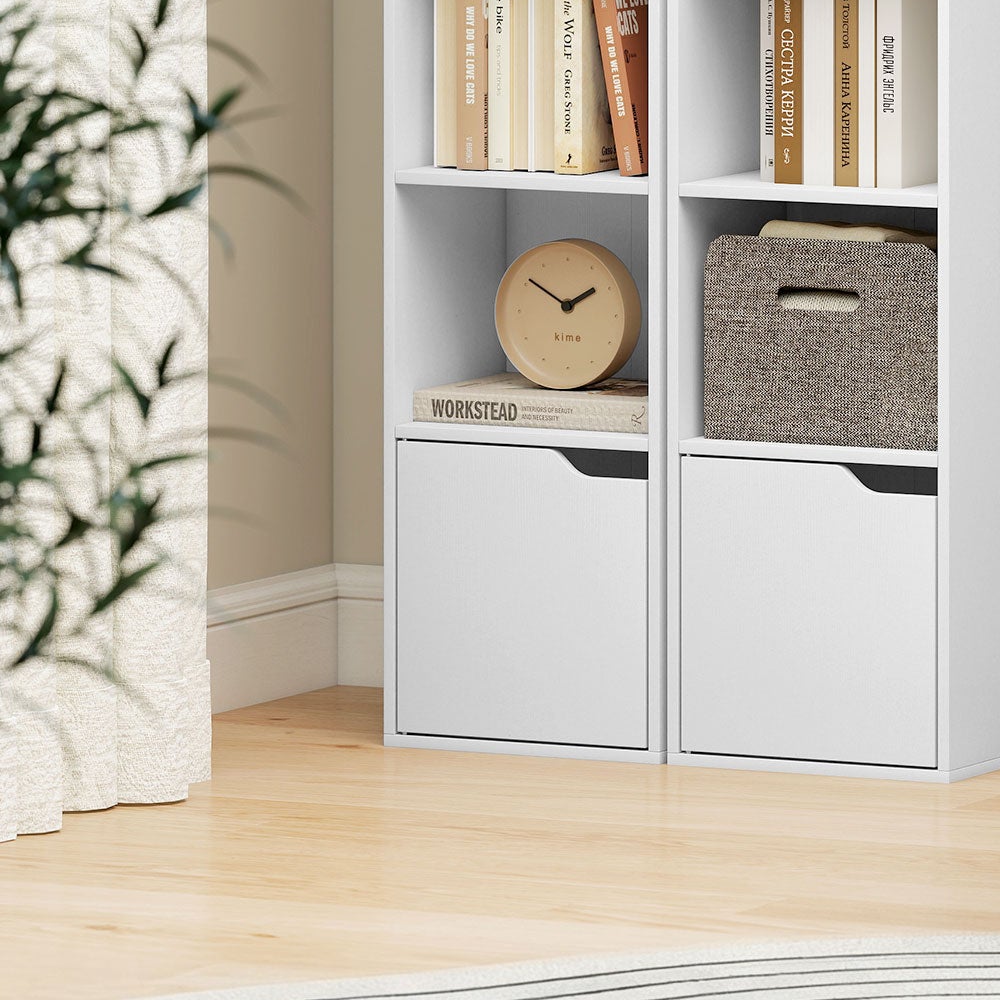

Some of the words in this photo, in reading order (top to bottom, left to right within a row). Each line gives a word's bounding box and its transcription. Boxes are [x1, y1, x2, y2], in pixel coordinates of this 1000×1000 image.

[465, 6, 475, 26] WHY
[496, 6, 504, 34] bike
[563, 0, 573, 16] the
[465, 28, 475, 40] DO
[605, 25, 615, 44] WHY
[616, 9, 639, 36] CATS
[465, 42, 475, 57] WE
[563, 18, 575, 60] WOLF
[607, 45, 617, 58] DO
[781, 28, 794, 85] СЕСТРА
[882, 35, 895, 75] ФРИДРИХ
[465, 58, 475, 80] LOVE
[610, 58, 619, 73] WE
[564, 69, 573, 98] GREG
[612, 73, 623, 95] LOVE
[841, 61, 851, 98] АННА
[465, 82, 475, 104] CATS
[765, 48, 774, 136] СТИХОТВОРЕНИЯ
[882, 78, 895, 114] ЭНГЕЛЬС
[563, 101, 573, 135] STONE
[615, 96, 626, 117] CATS
[781, 89, 794, 137] КЕРРИ
[841, 101, 851, 168] КАРЕНИНА
[554, 332, 581, 342] kime
[431, 398, 518, 422] WORKSTEAD
